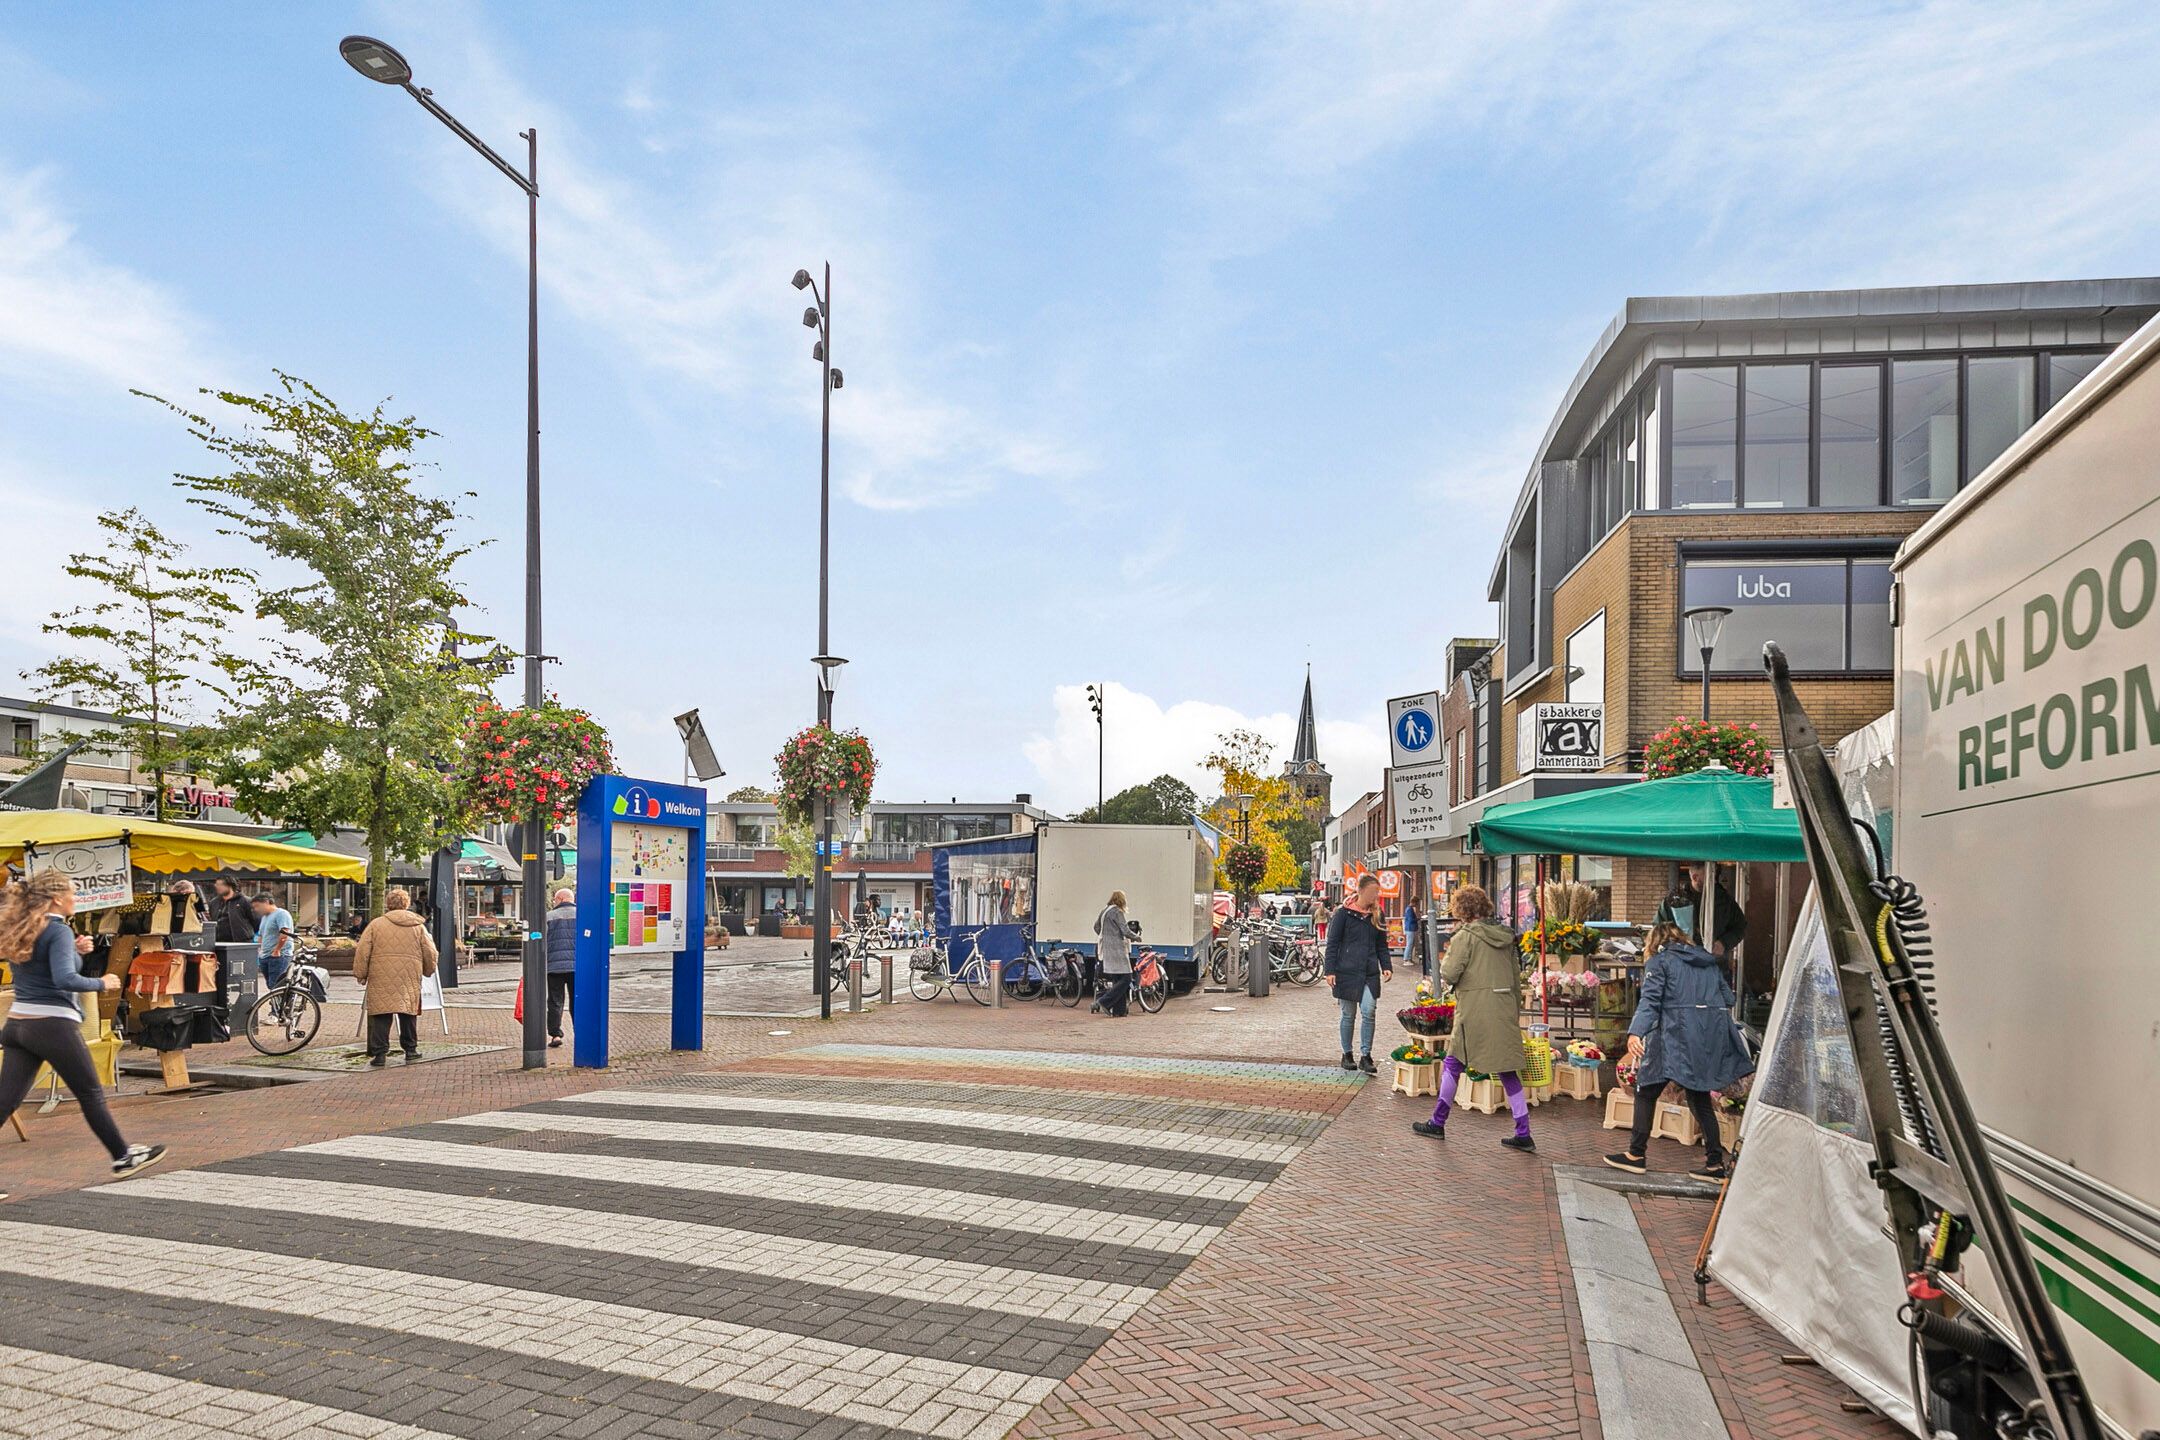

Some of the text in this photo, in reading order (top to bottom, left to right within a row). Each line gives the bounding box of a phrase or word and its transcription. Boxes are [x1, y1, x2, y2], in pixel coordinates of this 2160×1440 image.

[1737, 574, 1791, 599] luba
[1924, 539, 2158, 712] VAN DOO
[1401, 698, 1425, 709] ZONE
[1550, 705, 1590, 718] bakker
[1538, 756, 1601, 767] ammerlaan
[1394, 770, 1444, 783] uitgezonderd
[664, 801, 701, 816] Welkom
[1402, 815, 1443, 825] koopavond
